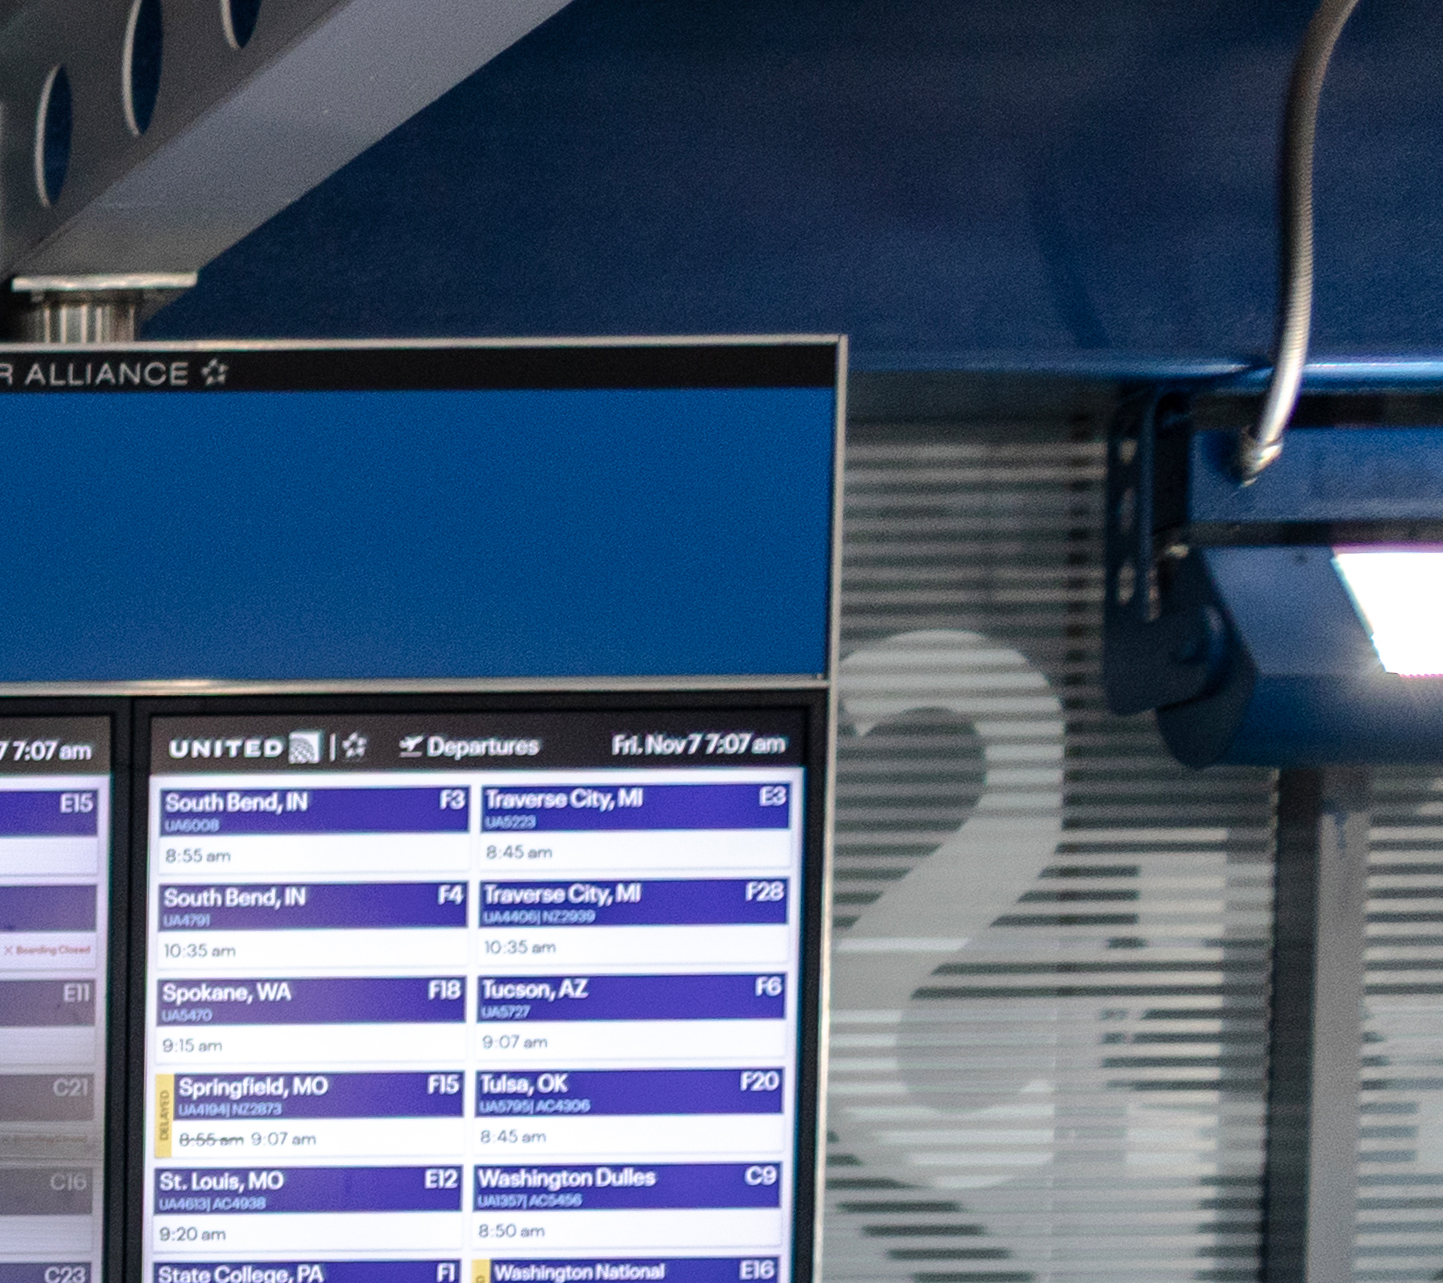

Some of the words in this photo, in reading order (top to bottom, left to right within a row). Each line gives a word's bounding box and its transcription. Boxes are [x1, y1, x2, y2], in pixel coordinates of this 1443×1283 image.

[24, 362, 189, 387] ALLIANCE
[163, 791, 225, 810] South
[228, 794, 282, 812] Bend,
[284, 790, 307, 809] IN
[442, 791, 464, 807] F3
